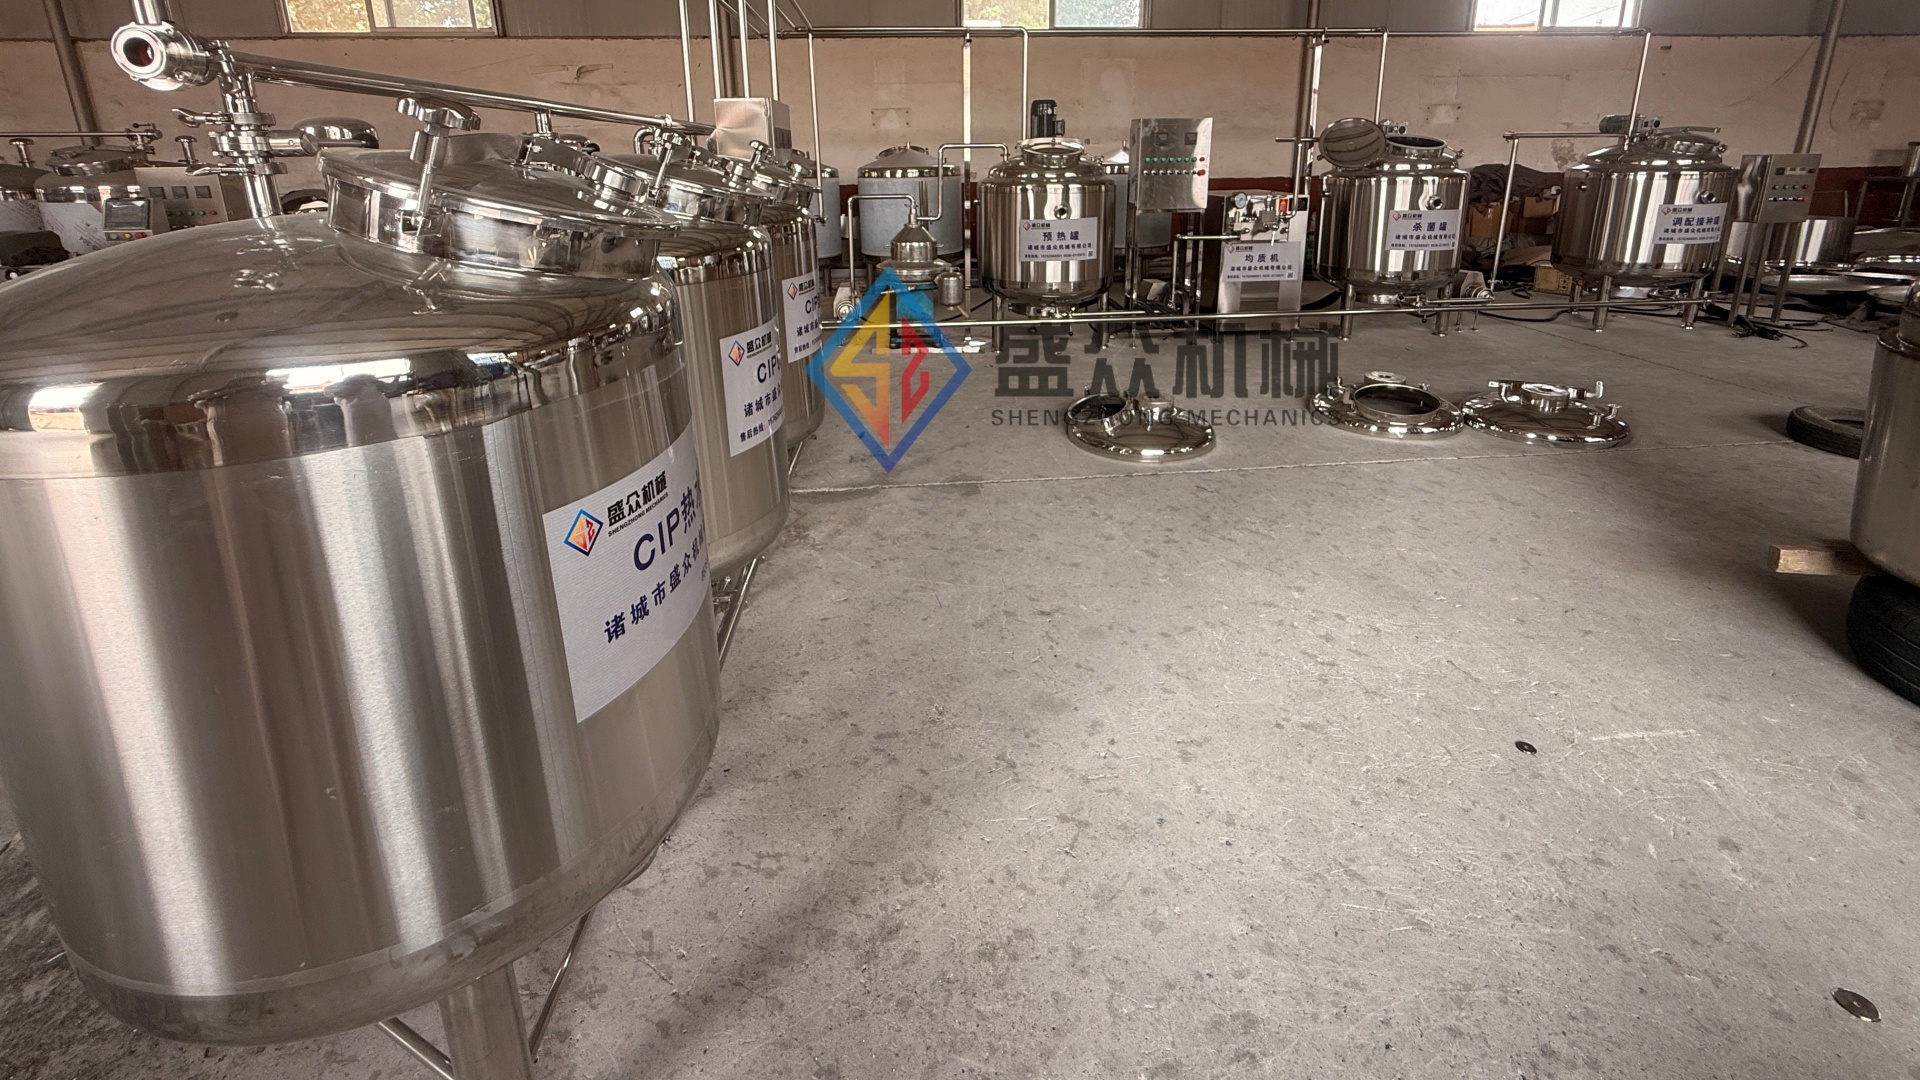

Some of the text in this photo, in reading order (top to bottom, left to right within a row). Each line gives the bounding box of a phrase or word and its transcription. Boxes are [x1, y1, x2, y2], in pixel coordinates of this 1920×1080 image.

[1042, 230, 1080, 241] 预热罐
[1245, 254, 1279, 263] 均质机
[804, 293, 820, 314] CIP
[757, 354, 780, 383] CIP
[607, 470, 668, 528] 盛众机械
[608, 492, 668, 537] SHENGZHONG MECHANICS
